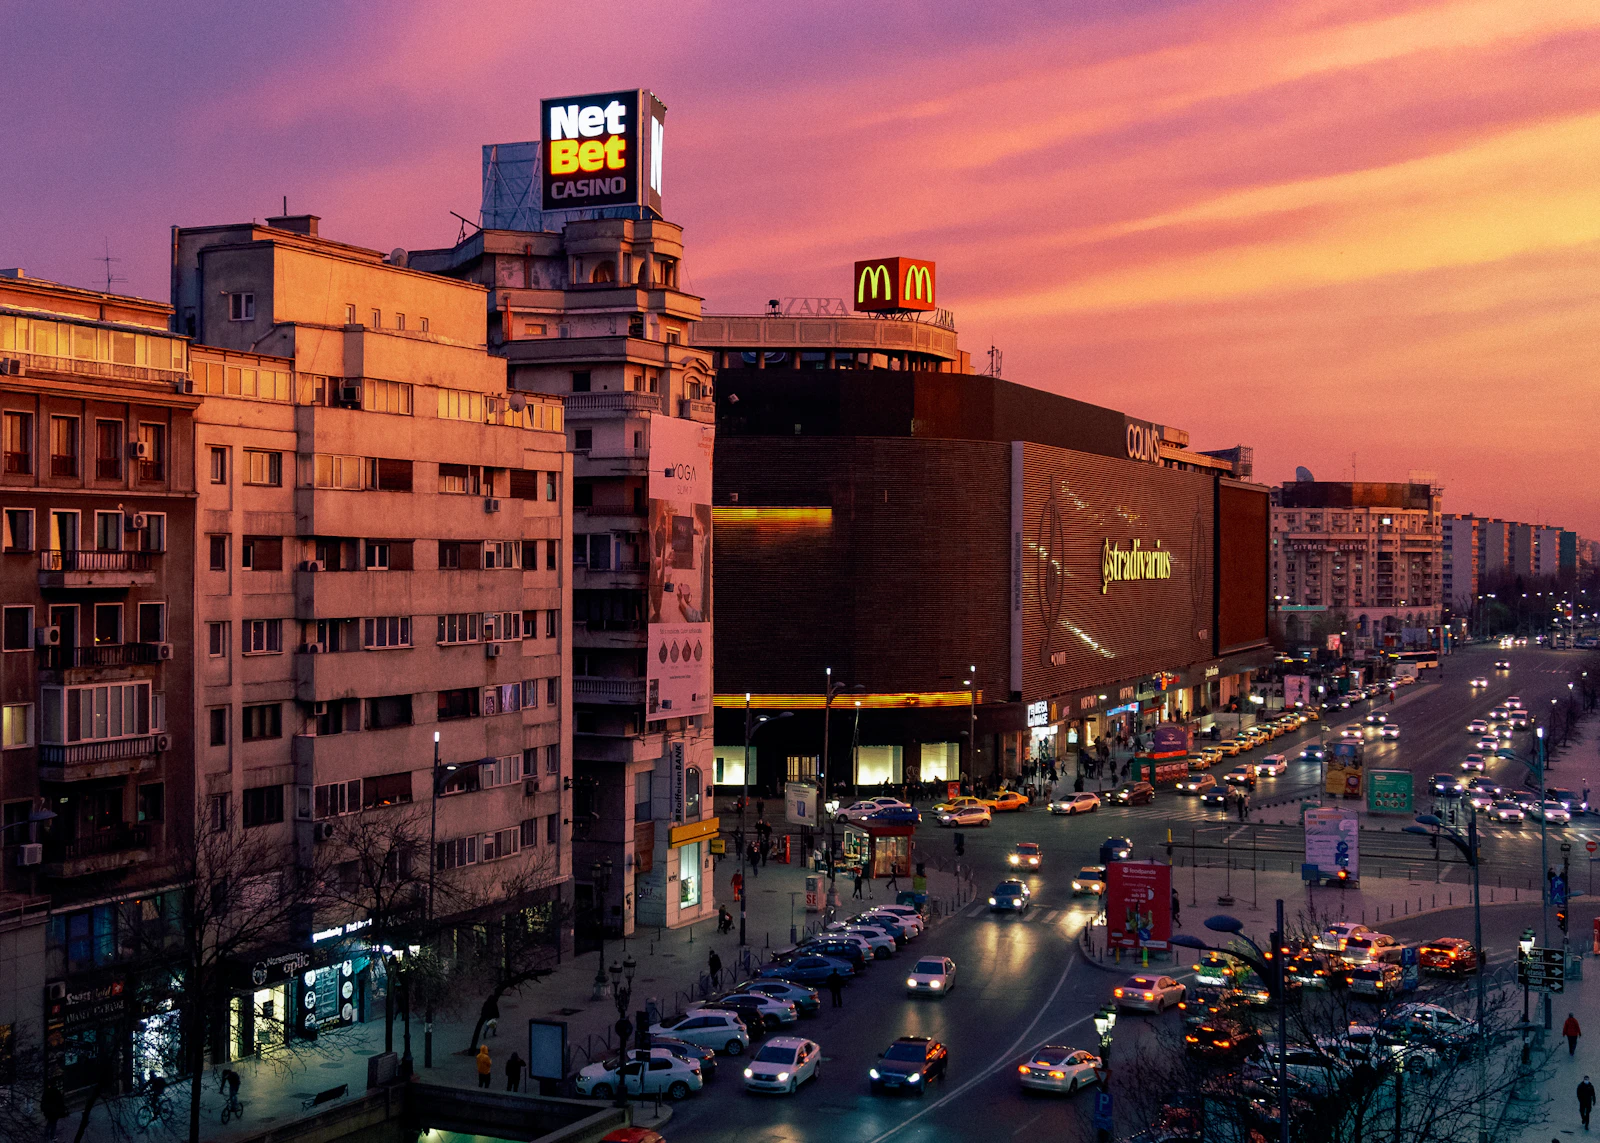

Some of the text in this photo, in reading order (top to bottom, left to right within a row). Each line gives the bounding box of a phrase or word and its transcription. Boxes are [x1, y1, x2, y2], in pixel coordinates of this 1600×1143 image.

[550, 100, 626, 140] Net
[550, 134, 626, 174] Bet
[551, 176, 626, 199] CASINO
[784, 297, 851, 316] ZARA
[671, 462, 697, 482] YOGA
[1013, 532, 1021, 611] www.stradivarius.com
[1103, 537, 1171, 588] stradivarius
[1129, 867, 1157, 875] foodpanda
[283, 951, 310, 978] optic
[1099, 1093, 1109, 1111] P
